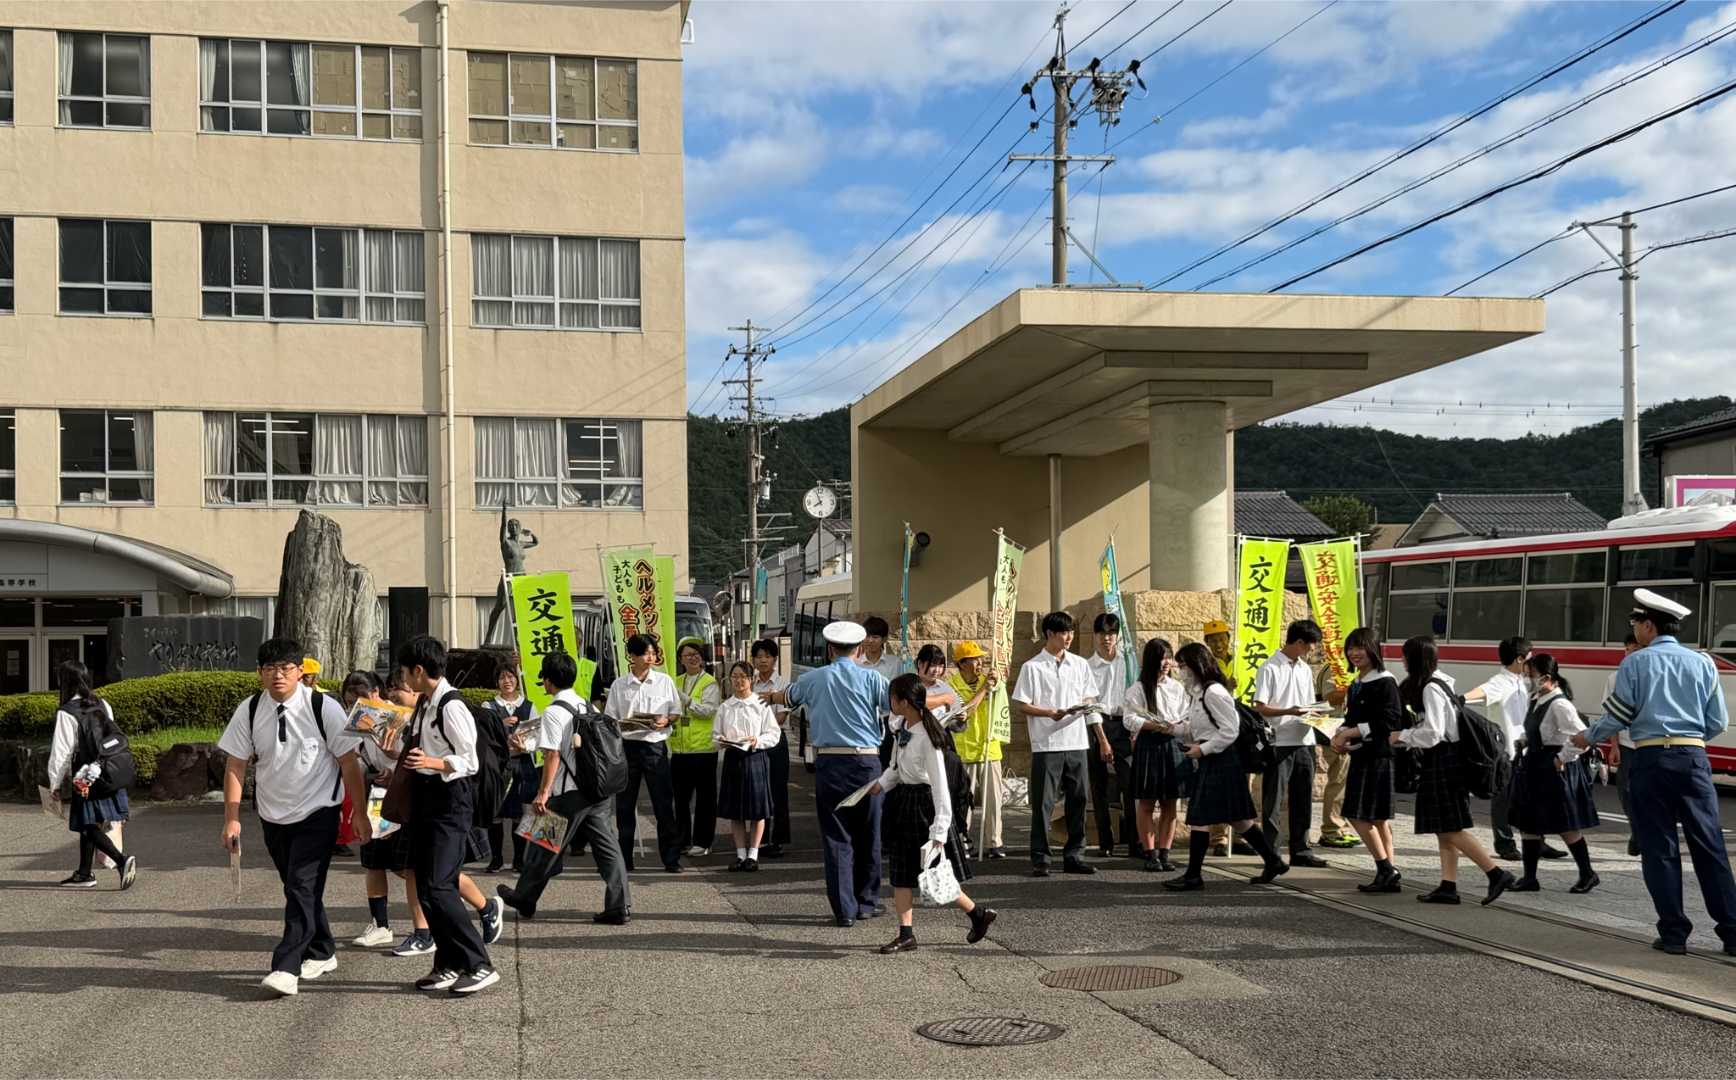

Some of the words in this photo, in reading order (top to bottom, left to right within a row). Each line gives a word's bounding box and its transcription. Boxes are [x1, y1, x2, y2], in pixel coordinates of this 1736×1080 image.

[612, 564, 626, 604] 子どもも
[621, 559, 633, 588] 大人も
[633, 558, 665, 667] ヘルメット
